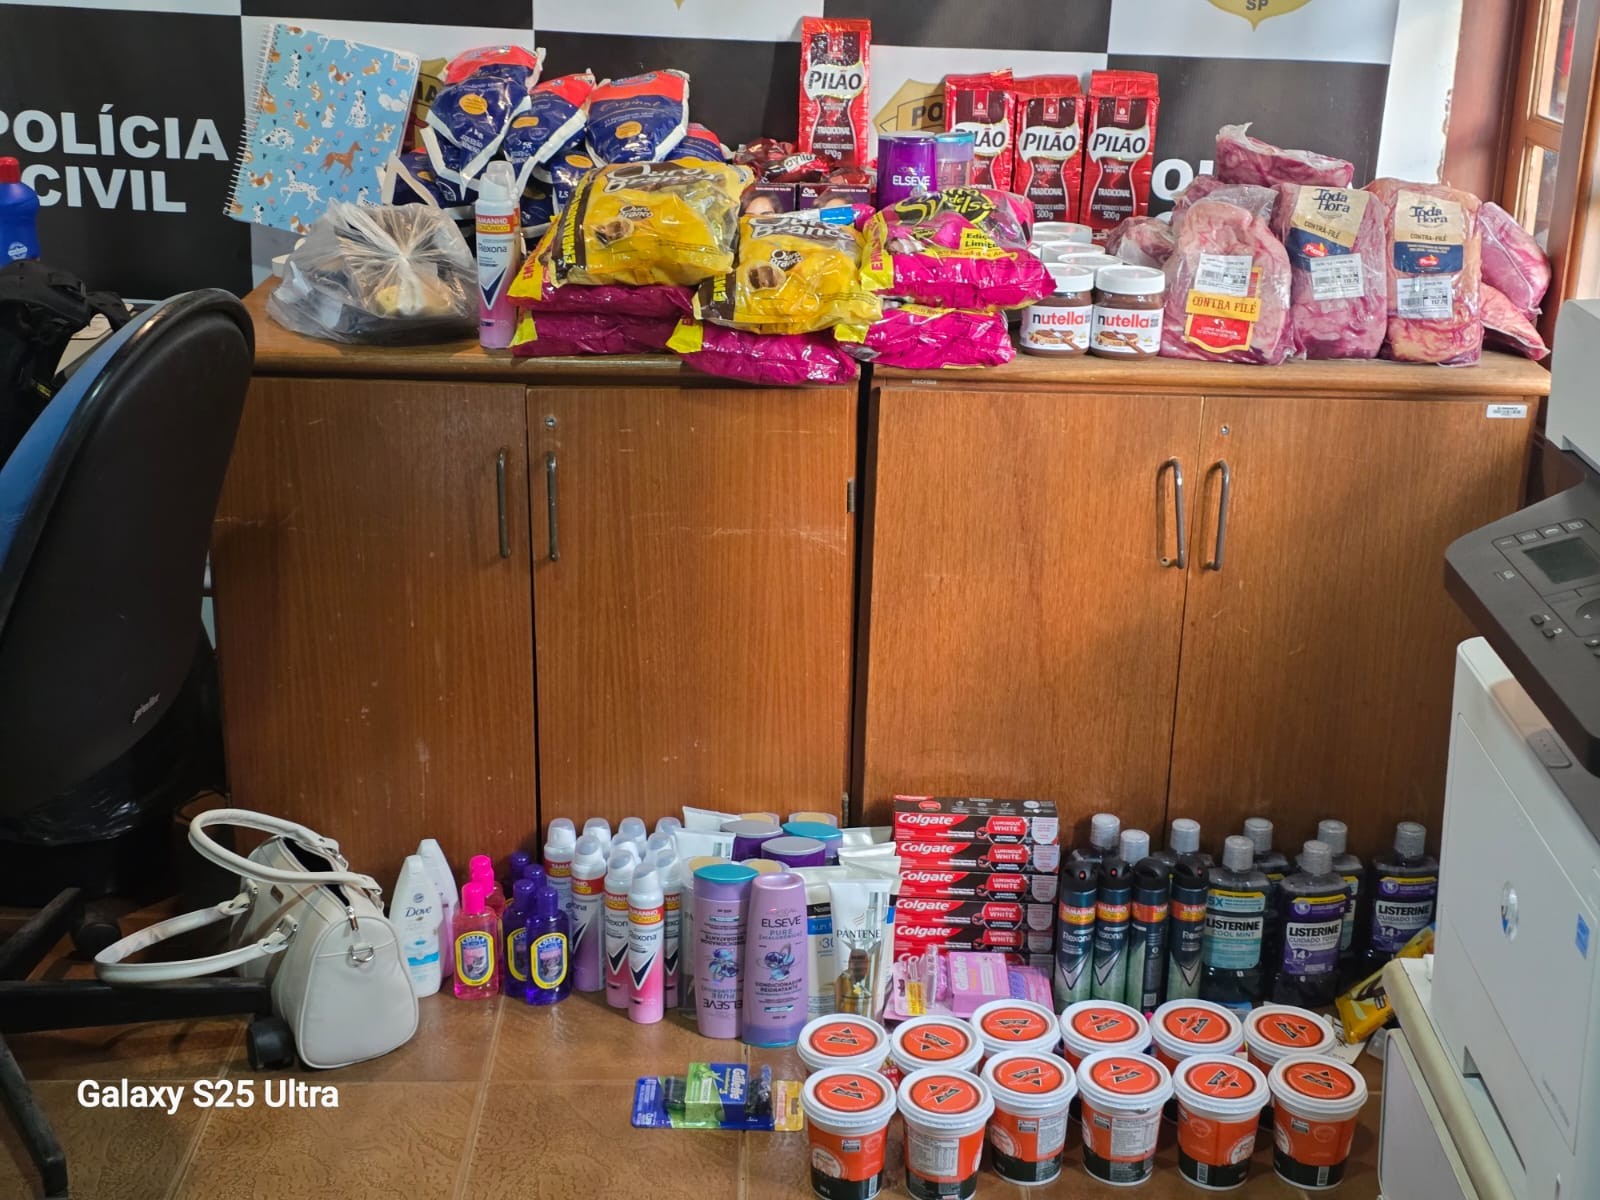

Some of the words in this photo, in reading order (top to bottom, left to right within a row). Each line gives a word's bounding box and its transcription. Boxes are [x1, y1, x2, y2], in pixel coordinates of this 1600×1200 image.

[808, 69, 862, 90] PILÃO
[0, 104, 229, 161] OLÍCIA
[955, 128, 1005, 147] LÃO
[1022, 131, 1076, 151] PILÃO
[1092, 133, 1146, 153] PILÃO
[892, 175, 931, 186] ELSEVE
[21, 164, 187, 213] CIVIL
[1312, 188, 1348, 202] Toda
[1318, 200, 1350, 213] Hora
[1409, 205, 1442, 217] Toda
[1036, 209, 1054, 219] 500g
[1102, 211, 1120, 221] 500g
[1417, 215, 1448, 224] Hora
[1192, 296, 1230, 311] CONTRA
[1234, 302, 1256, 314] FILÉ
[1033, 311, 1083, 325] nutella
[1098, 314, 1150, 328] nutella
[898, 813, 953, 826] Colgate
[901, 842, 955, 855] Colgate
[900, 870, 954, 883] Colgate
[405, 906, 432, 917] Dove
[896, 899, 950, 911] Colgate
[1378, 904, 1429, 916] LISTERINE
[761, 915, 801, 928] ELSEVE
[1207, 917, 1260, 931] LISTERINE
[837, 929, 881, 938] PANTENE
[896, 925, 951, 937] Colgate
[1063, 931, 1091, 942] Rexona
[1289, 924, 1340, 936] LISTERINE
[1381, 927, 1394, 937] 14
[1292, 950, 1306, 959] 14
[703, 999, 743, 1010] ELSEVE
[730, 1067, 745, 1100] Gillette
